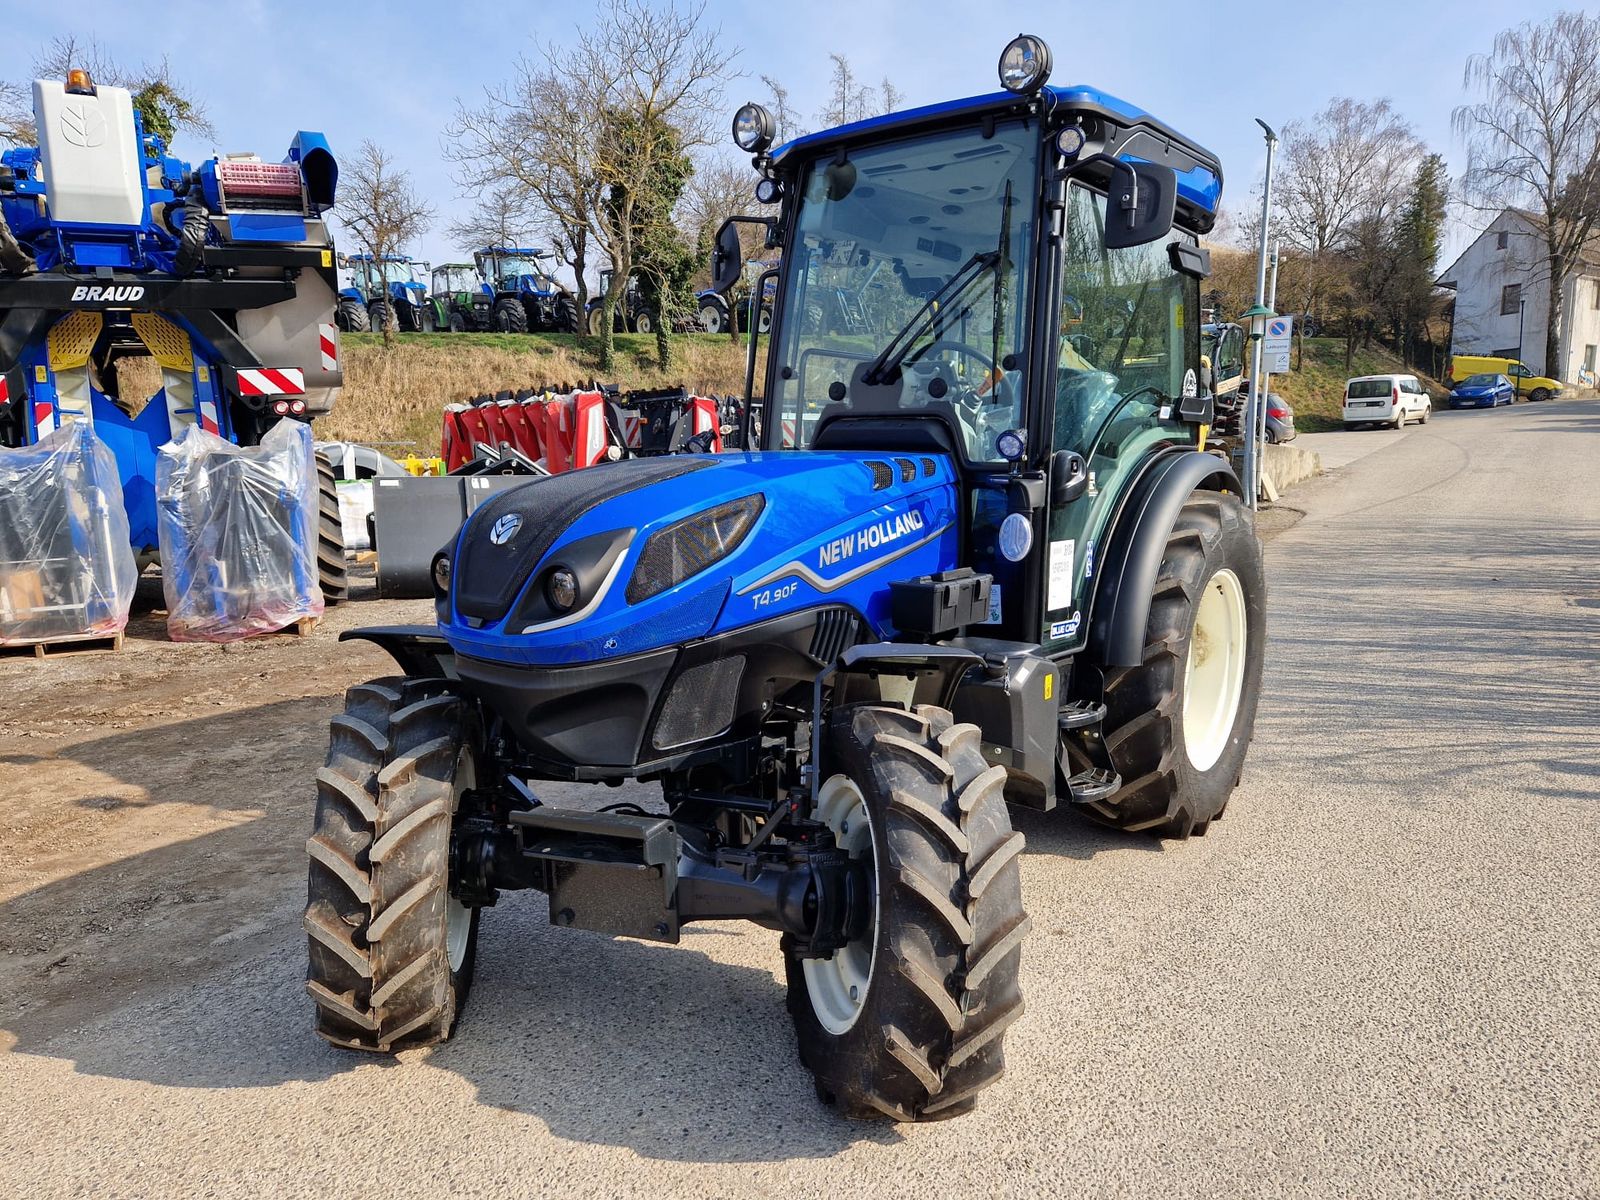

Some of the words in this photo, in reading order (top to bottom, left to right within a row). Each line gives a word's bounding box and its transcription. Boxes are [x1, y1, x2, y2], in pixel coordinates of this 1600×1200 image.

[71, 286, 145, 301] BRAUD
[819, 534, 854, 569] NEW
[857, 509, 924, 553] HOLLAND
[753, 582, 798, 610] T4.90F
[1052, 624, 1065, 636] BLUE
[1065, 623, 1075, 633] CAB
